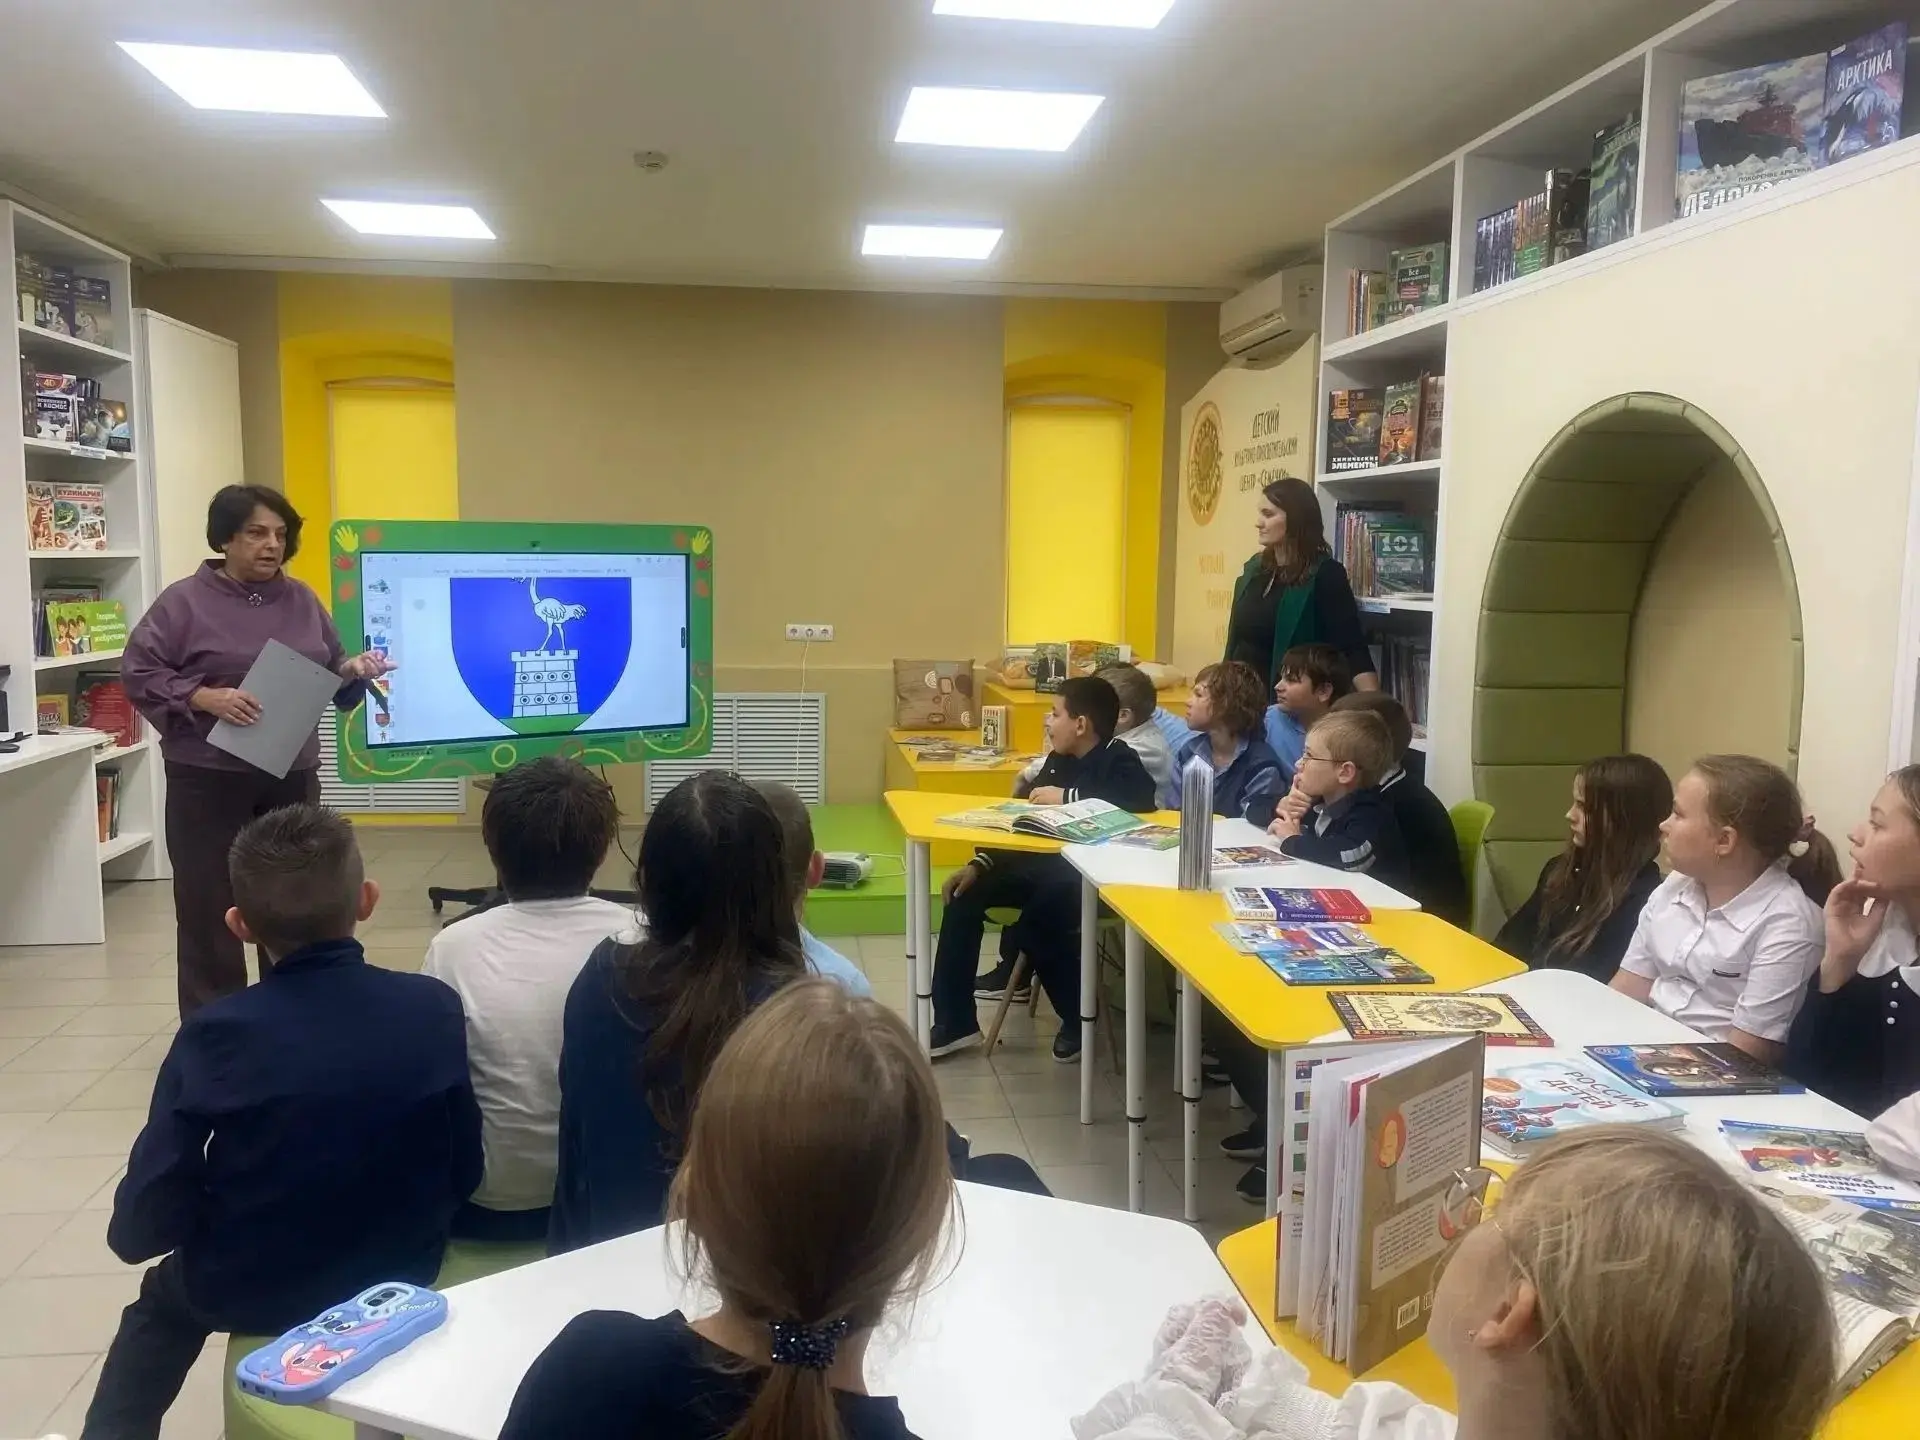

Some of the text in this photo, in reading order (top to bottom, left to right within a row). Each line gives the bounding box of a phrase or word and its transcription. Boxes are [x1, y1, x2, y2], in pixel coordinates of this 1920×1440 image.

[1836, 49, 1893, 91] АРКТИКА
[1738, 172, 1778, 183] ПОКОРЕНИЕ
[1252, 402, 1280, 439] ДЕТСКИЙ
[1331, 461, 1379, 470] ЭЛЕМЕНТЫ
[1332, 455, 1379, 463] ХИМИЧЕСКИЕ
[57, 489, 101, 498] КУЛИНАРИЯ
[1382, 535, 1419, 552] 101
[1542, 1079, 1617, 1109] ДЕТЕЙ
[1563, 1071, 1649, 1108] РОССИЯ
